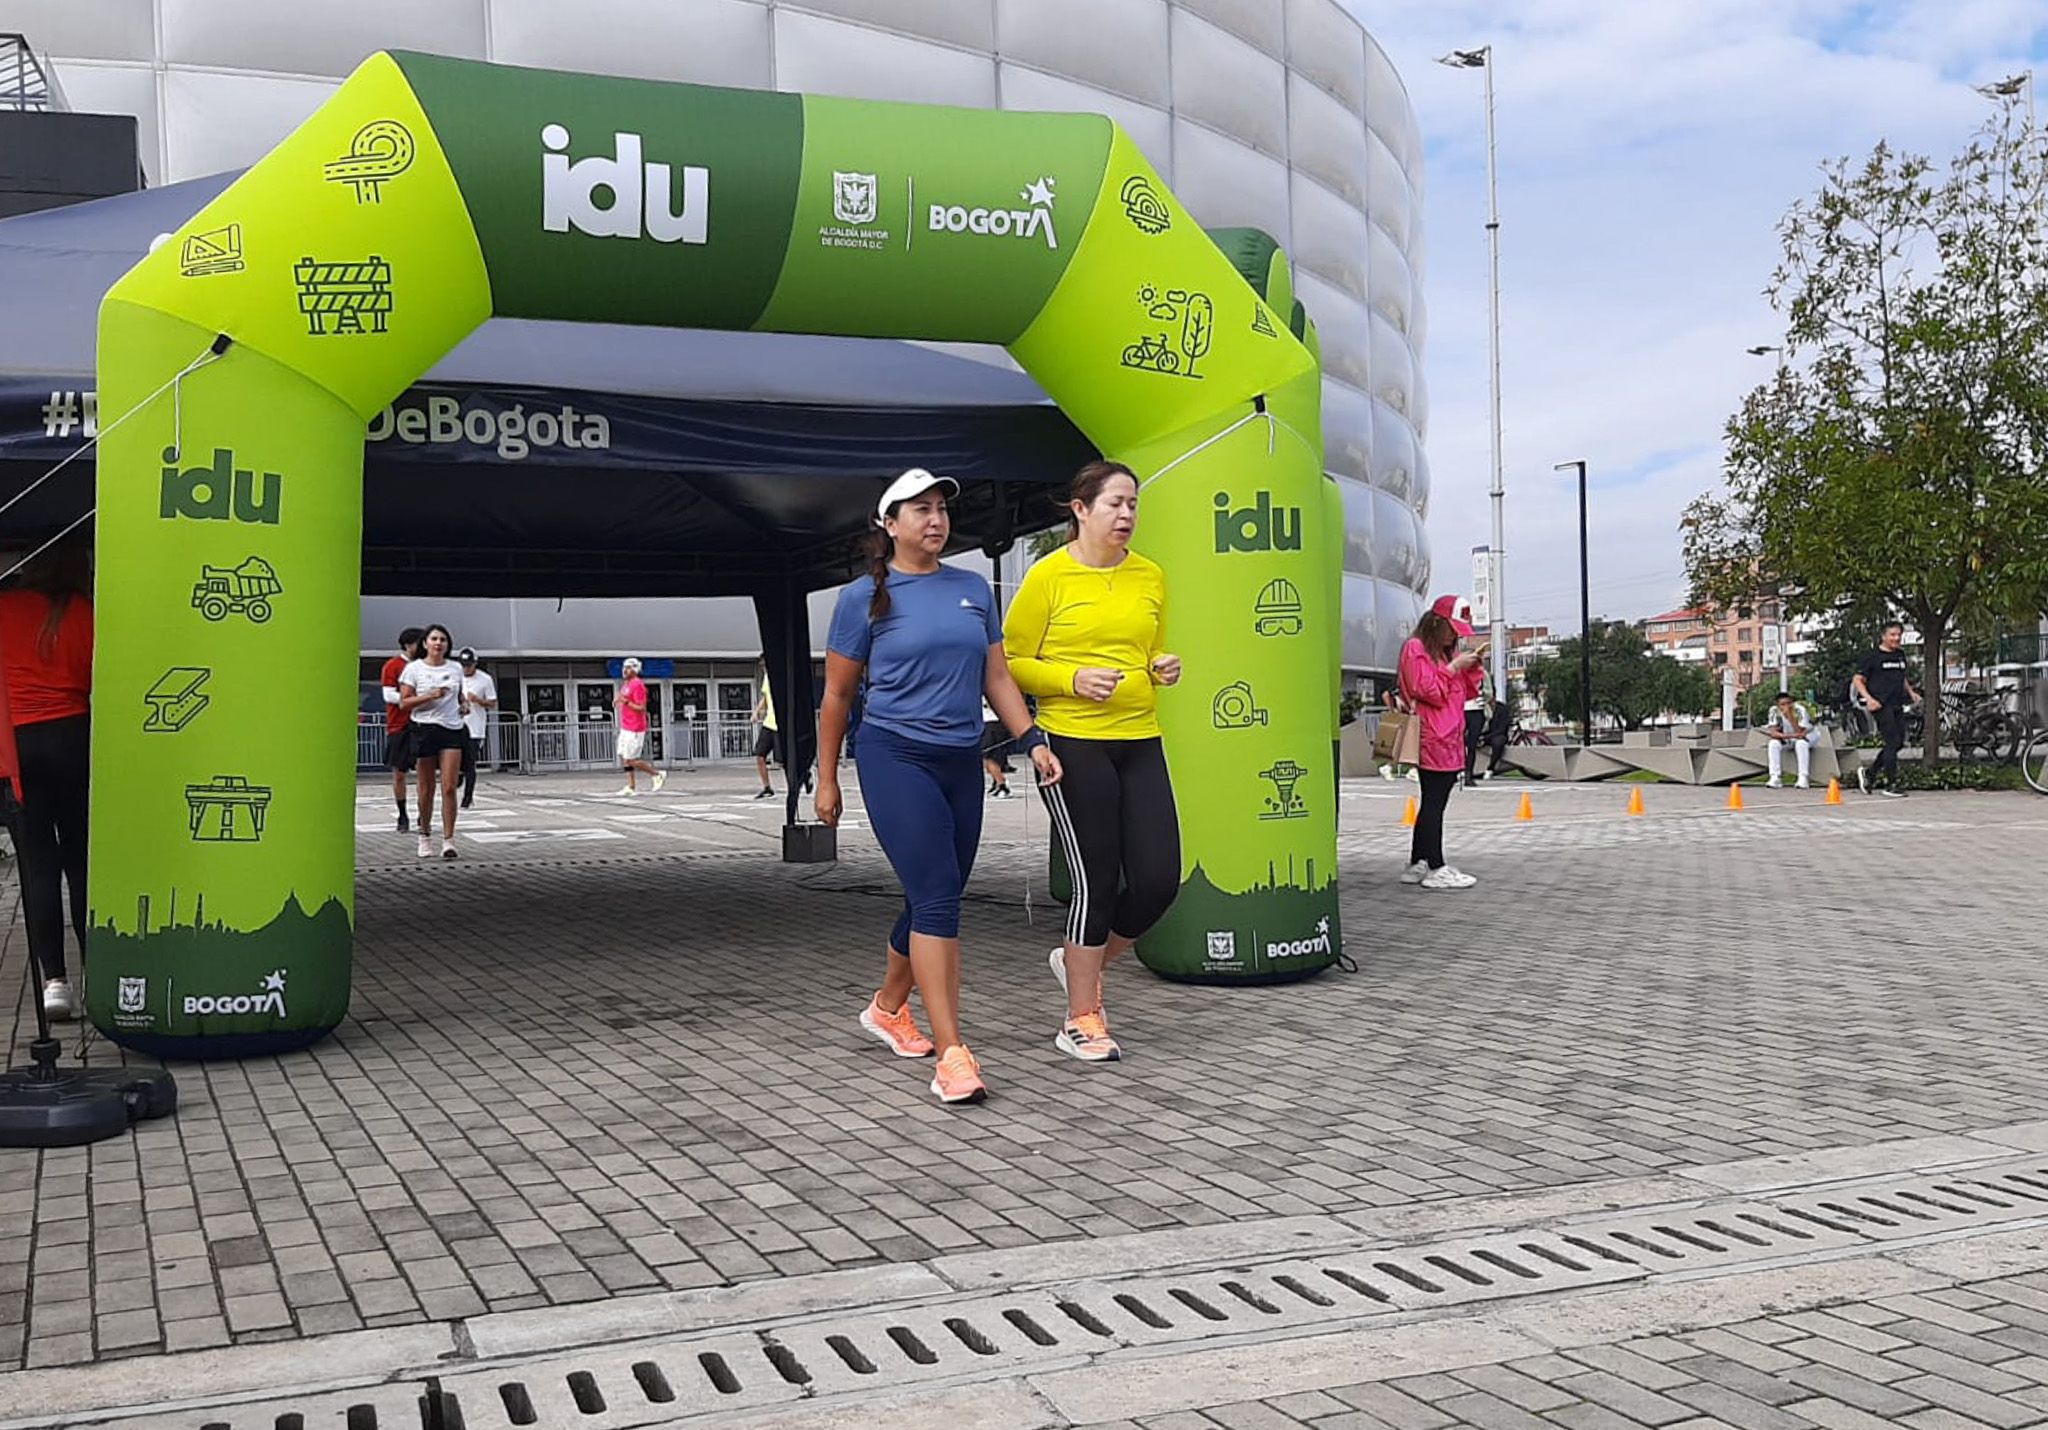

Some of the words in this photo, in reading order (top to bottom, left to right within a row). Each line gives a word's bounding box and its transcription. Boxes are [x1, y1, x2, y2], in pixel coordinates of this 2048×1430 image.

[541, 123, 709, 244] idu
[160, 446, 281, 524] idu
[1214, 491, 1302, 553] idu
